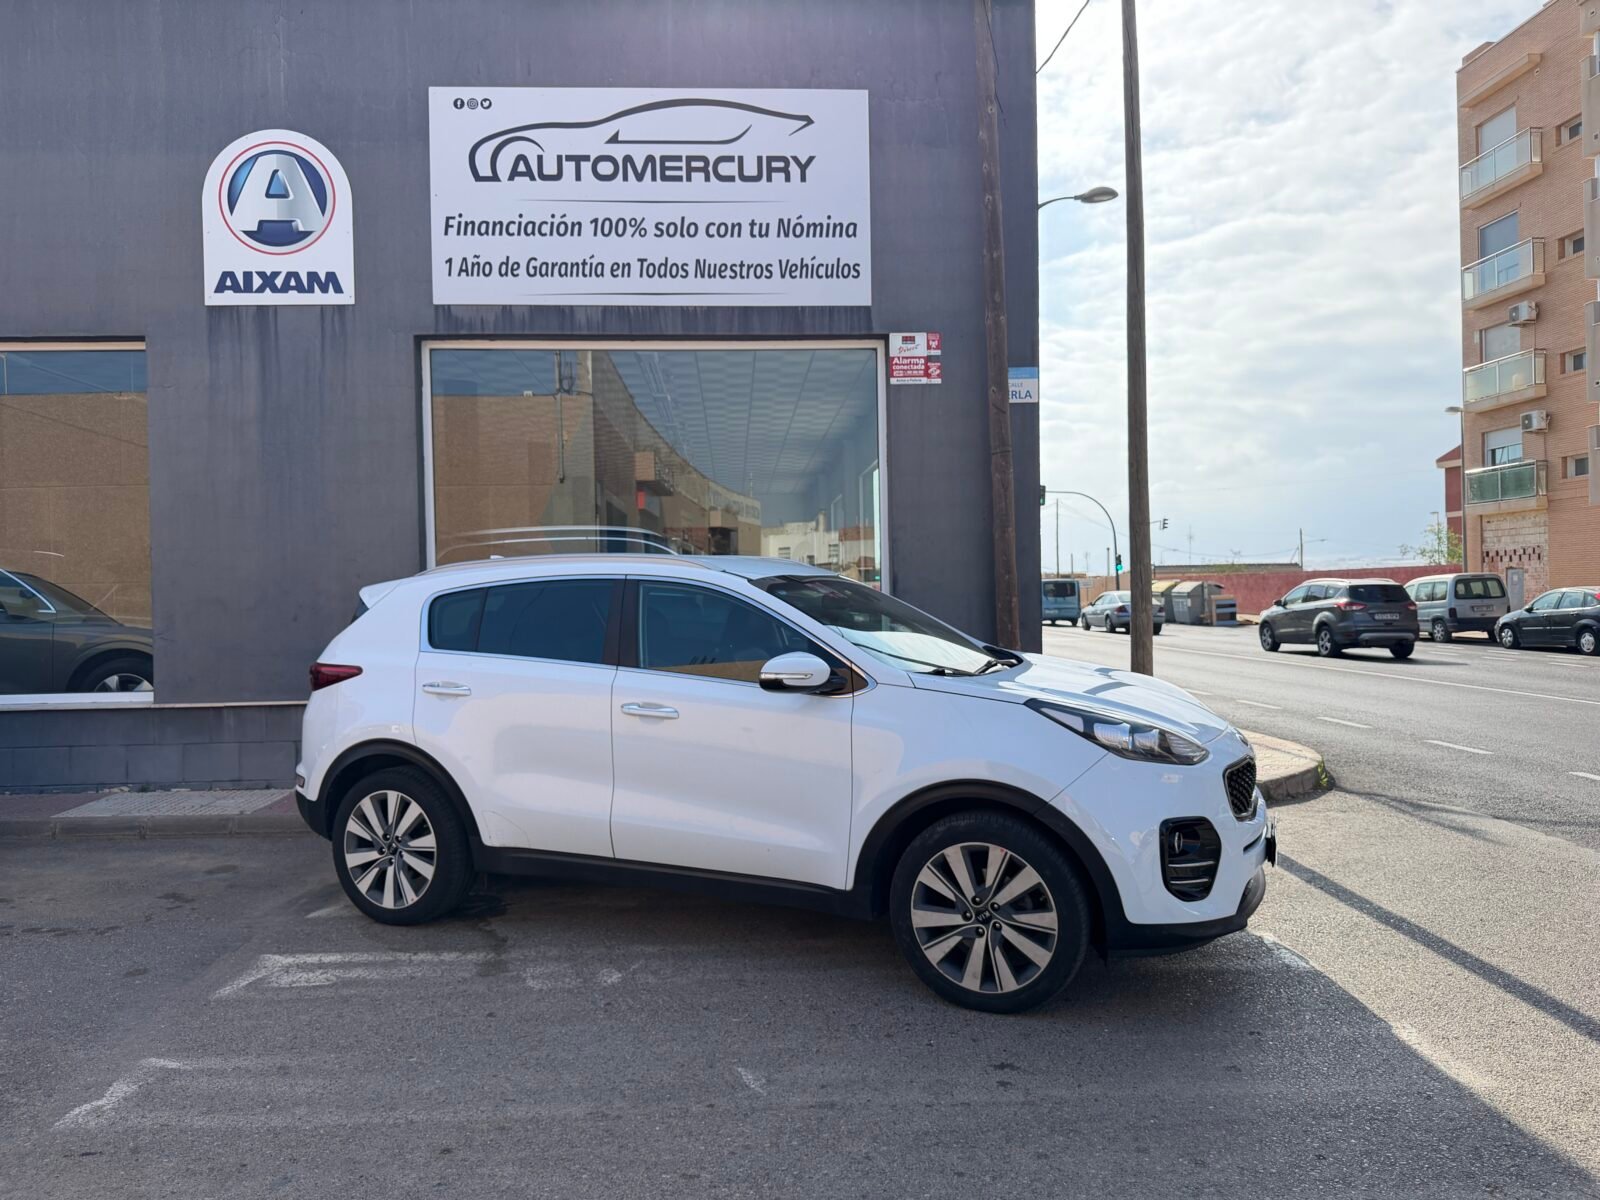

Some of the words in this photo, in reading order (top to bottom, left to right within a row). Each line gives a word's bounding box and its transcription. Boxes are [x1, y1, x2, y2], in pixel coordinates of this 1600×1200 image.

[507, 153, 816, 183] AUTOMERCURY
[443, 213, 583, 238] Financiación
[589, 216, 648, 239] 100%
[653, 215, 699, 239] solo
[704, 221, 743, 239] con
[748, 218, 771, 239] tu
[776, 214, 858, 239] Nómina
[444, 257, 453, 277] 1
[457, 254, 493, 278] Año
[497, 255, 521, 278] de
[525, 254, 605, 279] Garantía
[609, 261, 632, 279] en
[636, 256, 689, 279] Todos
[694, 258, 774, 280] Nuestros
[778, 255, 861, 281] Vehículos
[213, 270, 344, 294] AIXAM
[892, 357, 925, 365] Alarma
[1008, 389, 1032, 400] RLA
